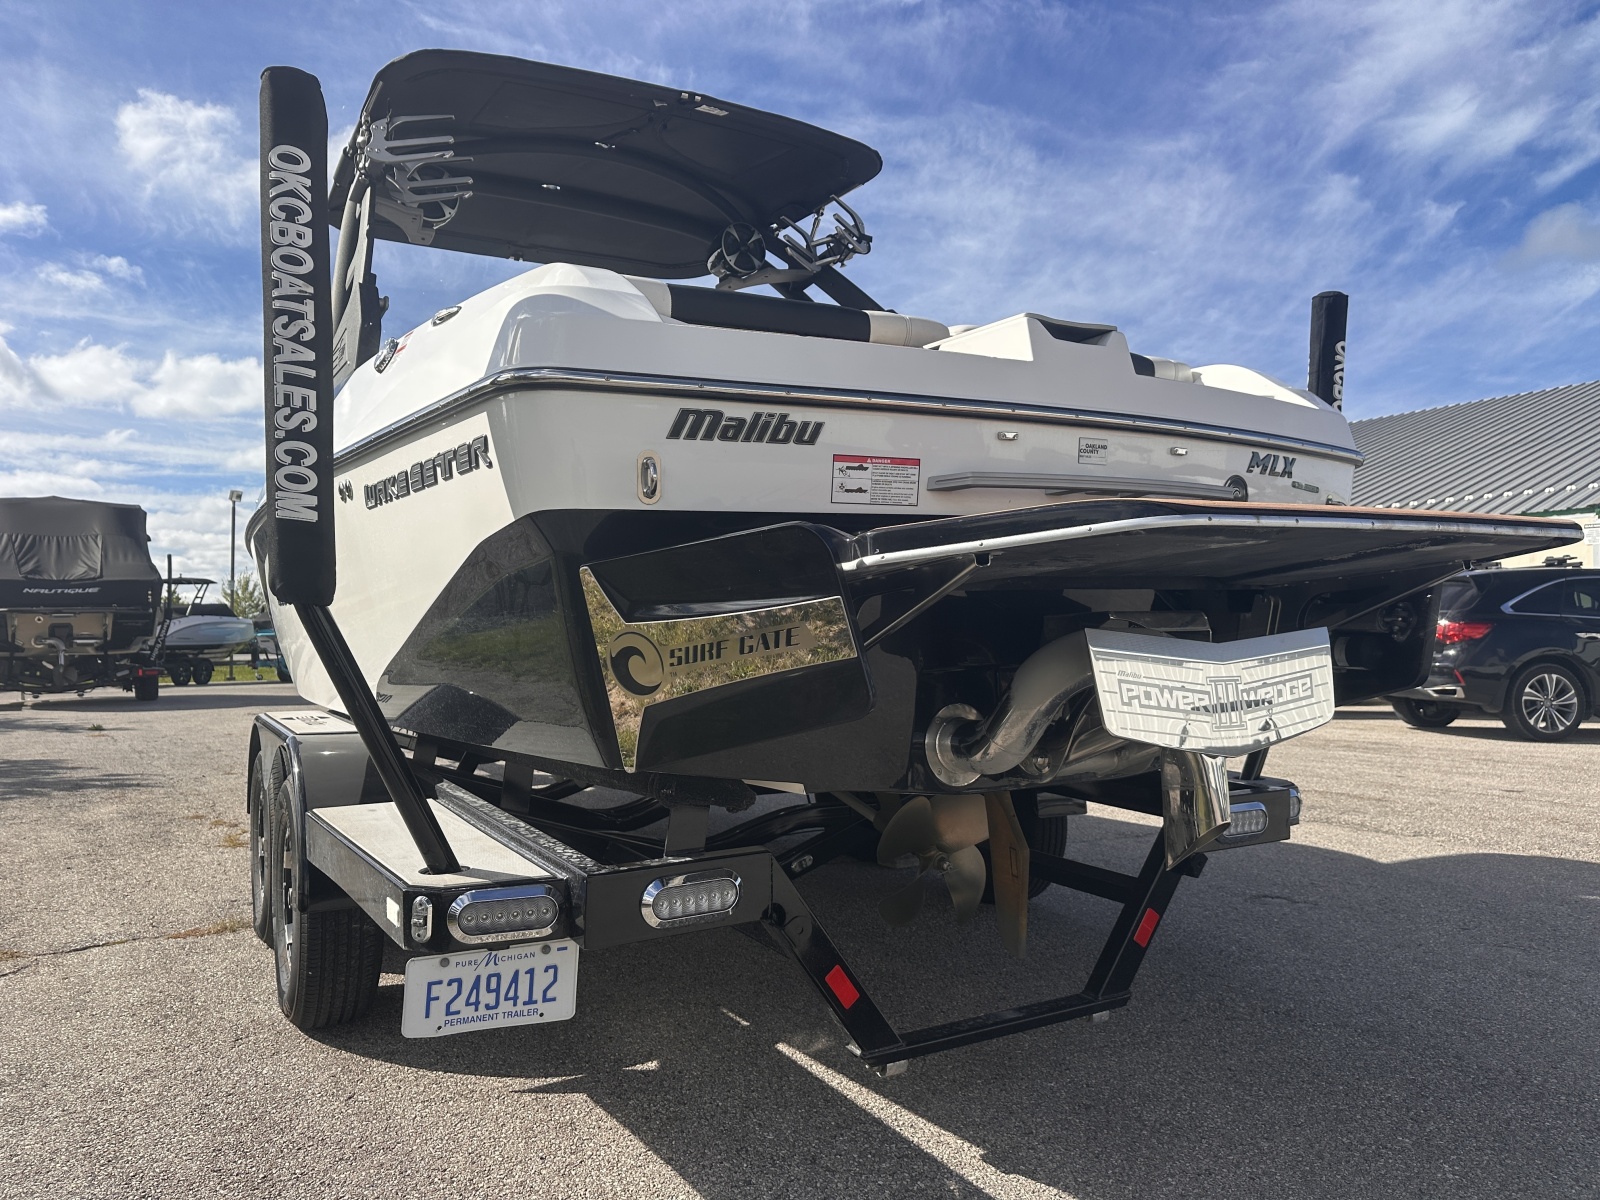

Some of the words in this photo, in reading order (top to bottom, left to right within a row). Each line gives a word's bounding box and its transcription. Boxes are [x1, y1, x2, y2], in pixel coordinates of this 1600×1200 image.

[267, 144, 320, 523] OKCBOATSALES.COM
[666, 407, 825, 445] Malibu
[364, 434, 493, 510] WAKESETTER
[1246, 451, 1296, 479] MLX
[669, 640, 729, 667] SURF
[739, 627, 801, 655] GATE
[1120, 684, 1209, 709] POWER
[455, 959, 479, 968] PURE
[474, 951, 536, 971] MICHIGAN
[425, 965, 558, 1018] F249412
[444, 1014, 500, 1027] PERMANENT
[502, 1008, 539, 1020] TRAILER
